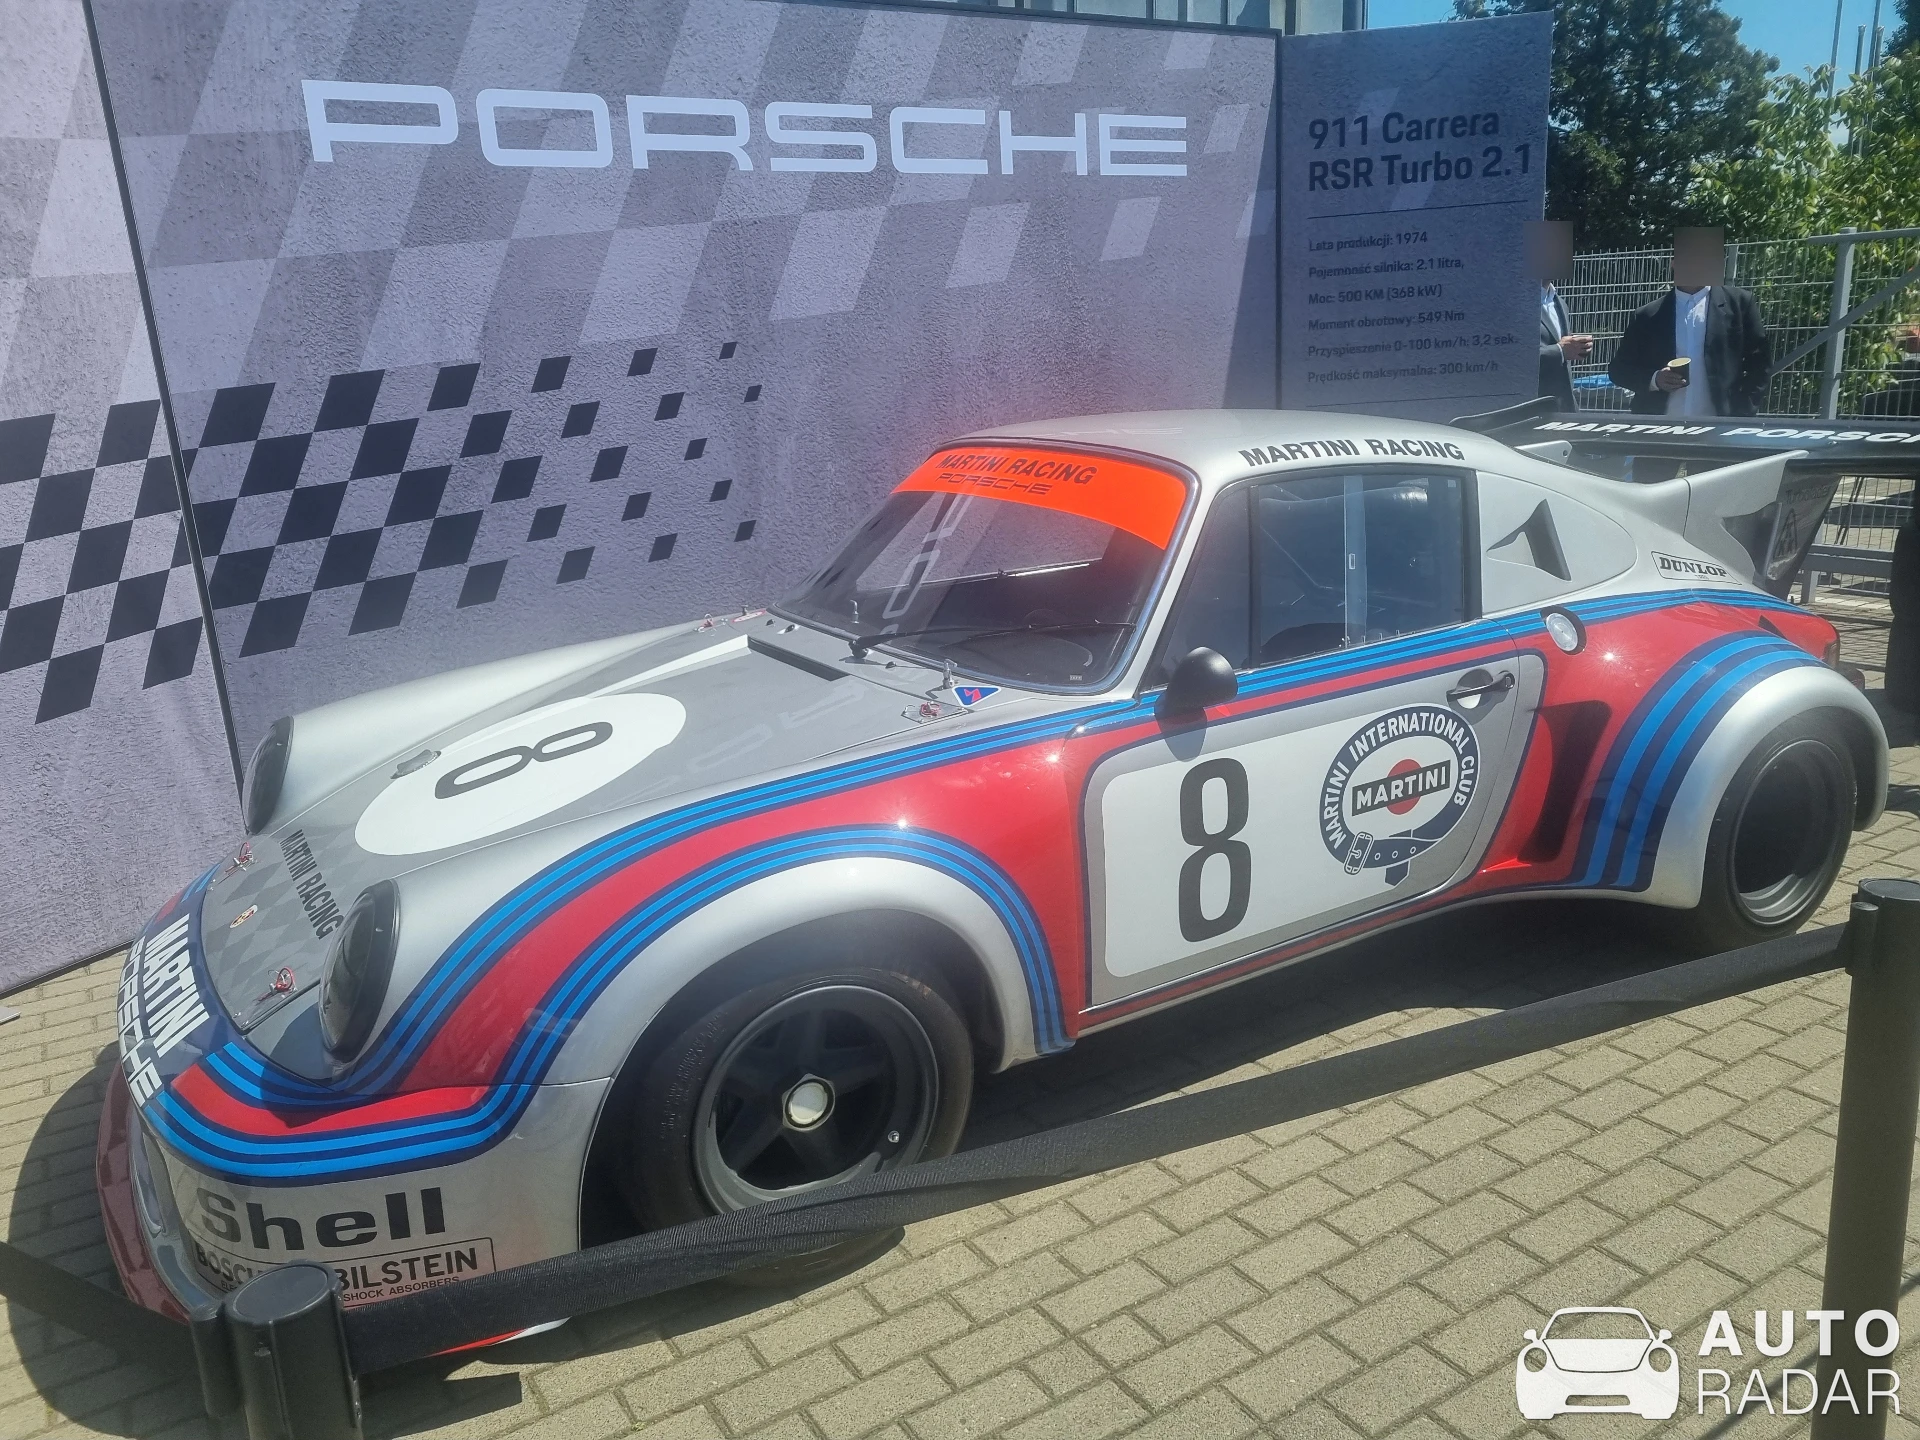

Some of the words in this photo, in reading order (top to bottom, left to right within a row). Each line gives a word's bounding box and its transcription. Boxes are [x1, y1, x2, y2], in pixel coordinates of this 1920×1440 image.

[302, 79, 1188, 177] PORSCHE
[1308, 114, 1369, 150] 911
[1382, 111, 1499, 144] Carrera
[1308, 157, 1374, 192] RSR
[1381, 151, 1473, 186] Turbo
[1482, 143, 1531, 178] 2.1
[1308, 237, 1334, 251] Lata
[1336, 236, 1394, 252] produkcji:
[1396, 231, 1428, 246] 1974
[1308, 262, 1371, 279] Pojemność
[1374, 259, 1414, 273] silnika:
[1438, 257, 1465, 270] litra,
[1308, 292, 1336, 305] Moc:
[1338, 290, 1363, 303] 500
[1365, 289, 1385, 301] KM
[1418, 284, 1443, 299] kW)
[1308, 318, 1355, 331] Moment
[1357, 316, 1416, 329] obrotowy:
[1418, 312, 1442, 324] 549
[1444, 311, 1465, 322] Nm
[1308, 342, 1392, 359] Przyspieszenie
[1394, 338, 1432, 352] 0-100
[1434, 335, 1470, 349] km/h:
[1472, 334, 1492, 347] 3,2
[1494, 333, 1519, 346] sek.
[1307, 369, 1361, 385] Prędkość
[1362, 365, 1437, 381] maksymalna:
[1439, 363, 1463, 375] 300
[1465, 360, 1499, 373] km/h
[1532, 420, 1717, 436] MARTINI
[935, 454, 1011, 473] MARTINI
[1004, 458, 1098, 485] RACING
[1238, 439, 1361, 467] MARTINI
[1363, 438, 1466, 461] RACING
[934, 472, 1054, 496] PORSCHE
[1658, 556, 1728, 577] DUNLOP
[434, 720, 614, 800] 8
[1324, 761, 1350, 850] MARTINI
[1348, 712, 1471, 763] INTERNATIONAL
[1453, 755, 1476, 807] CLUB
[1356, 765, 1447, 811] MARTINI
[279, 828, 318, 882] MARTINI
[1178, 757, 1252, 943] 8
[295, 871, 345, 941] RACING
[142, 913, 211, 1059] MARTINI
[117, 935, 163, 1109] PORSCHE
[195, 1186, 447, 1252] Shell
[343, 1288, 385, 1302] SHOCK
[388, 1276, 460, 1296] ABSORBERS
